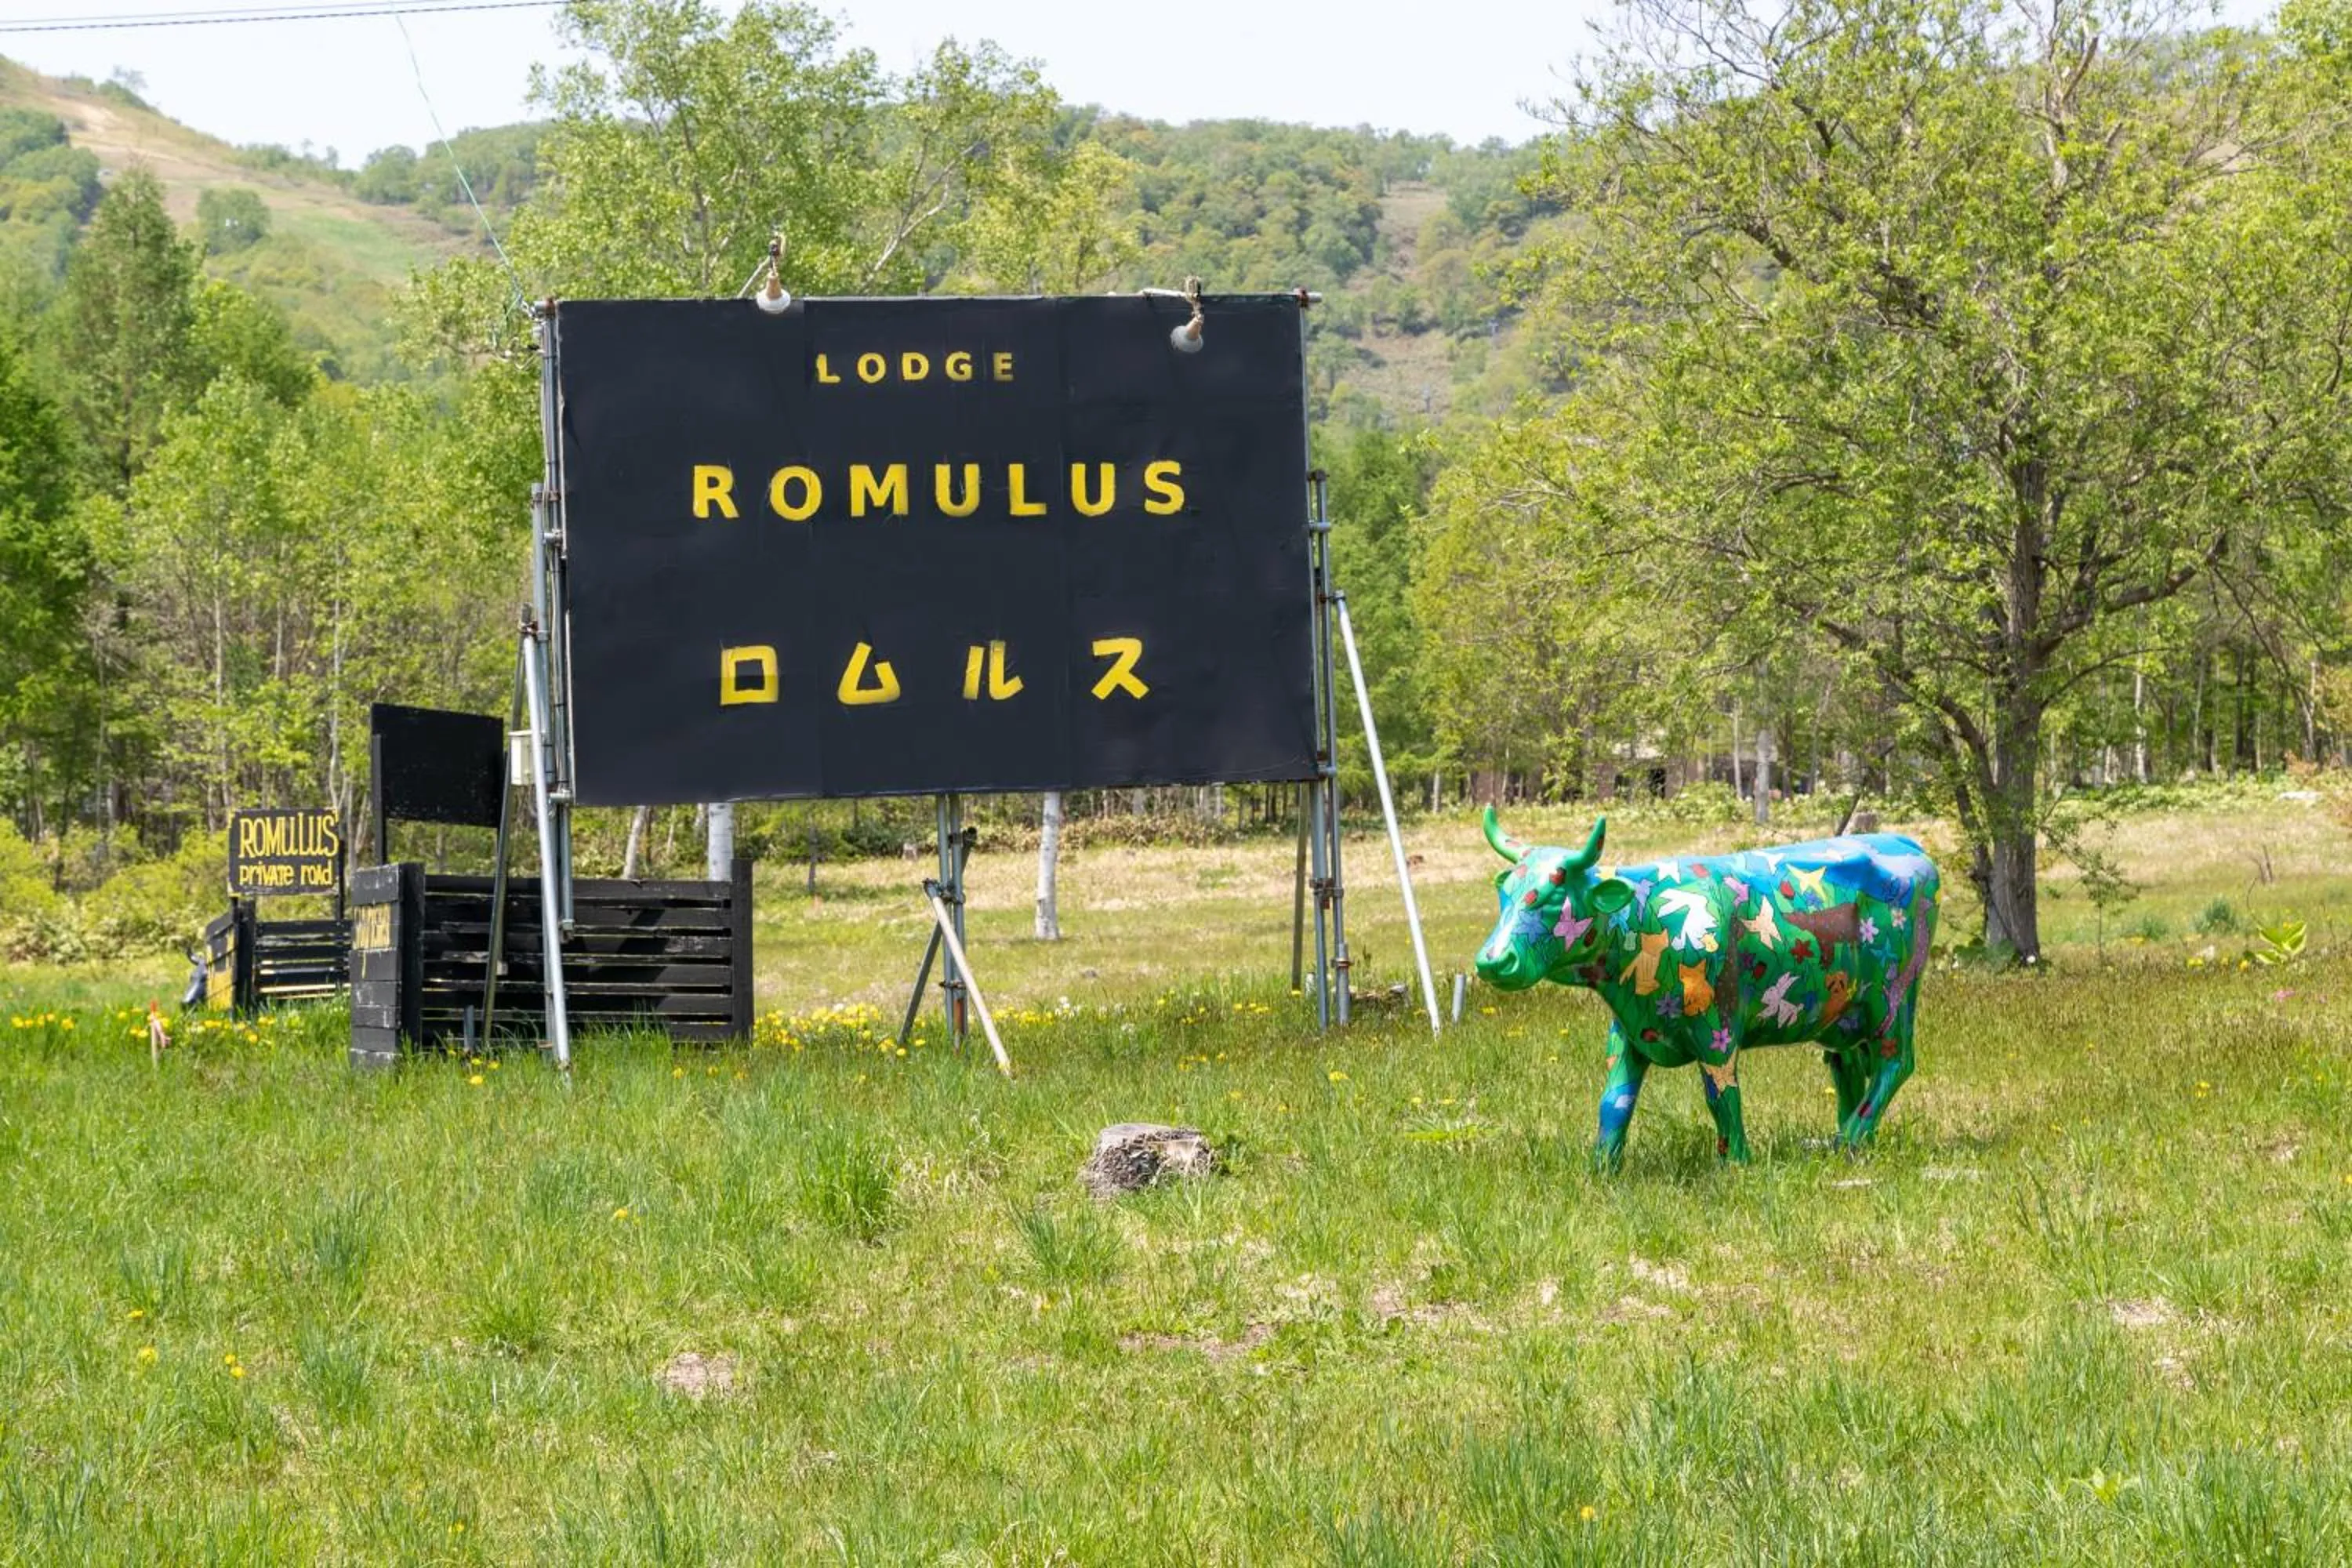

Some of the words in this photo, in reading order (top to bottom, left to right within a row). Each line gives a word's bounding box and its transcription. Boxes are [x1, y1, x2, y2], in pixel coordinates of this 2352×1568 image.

[815, 351, 1014, 383] LODGE
[693, 459, 1185, 521] ROMULUS
[719, 637, 1149, 706] ロムルス
[238, 812, 339, 858] ROMULUS
